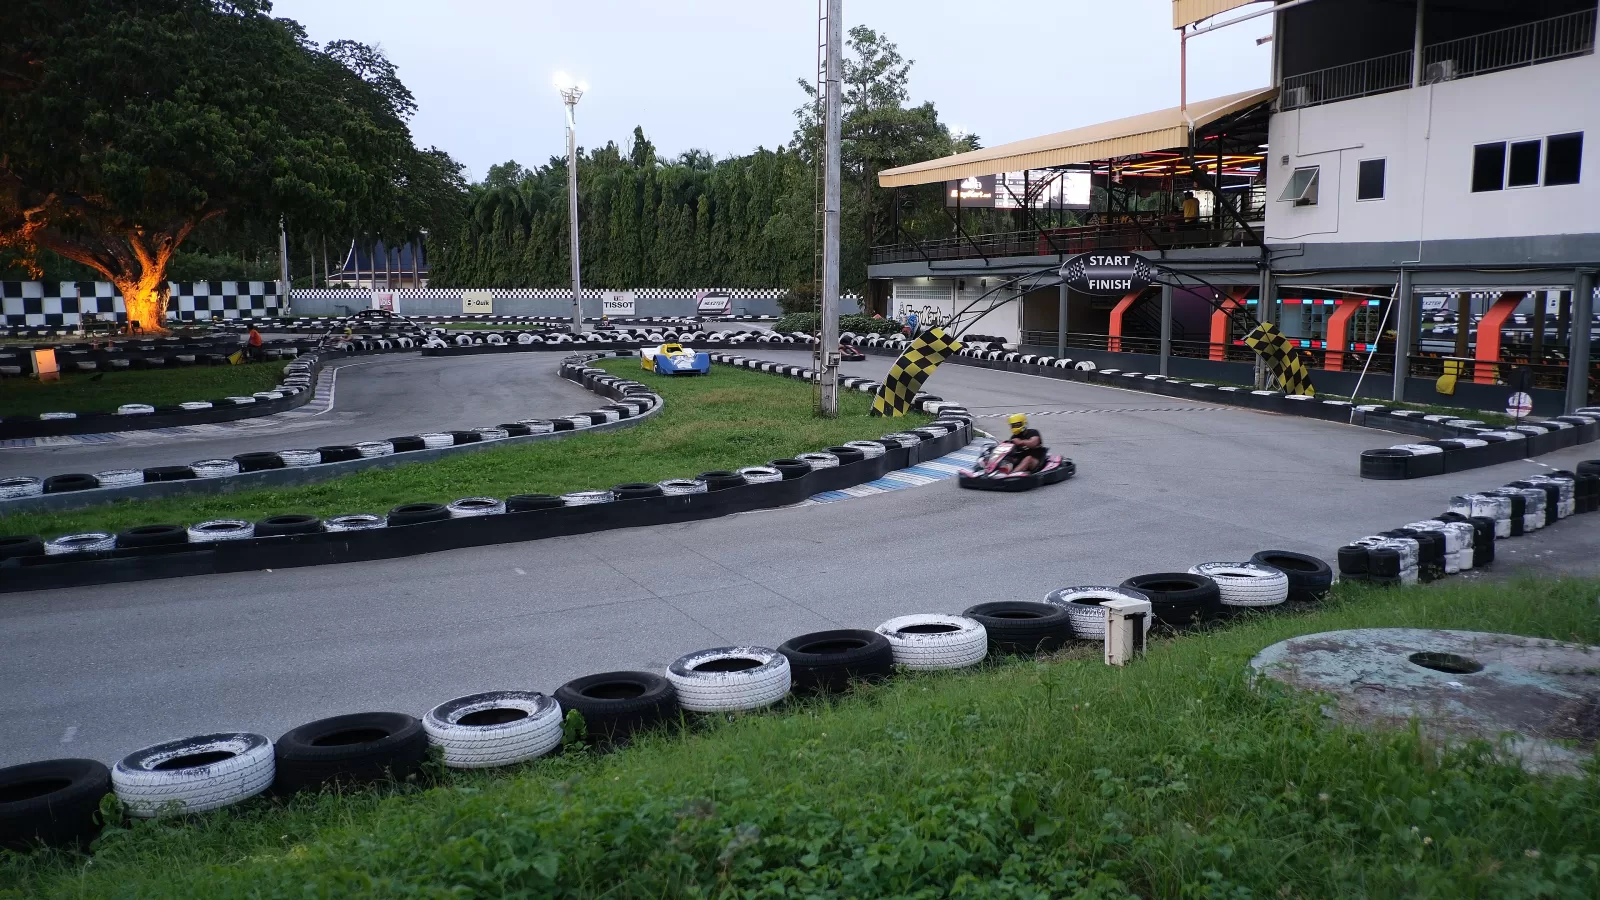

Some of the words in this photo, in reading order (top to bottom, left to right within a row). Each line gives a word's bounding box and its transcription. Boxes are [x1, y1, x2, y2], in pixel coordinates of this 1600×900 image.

[1089, 255, 1131, 266] START
[1089, 279, 1131, 290] FINISH
[603, 301, 634, 309] TISSOT
